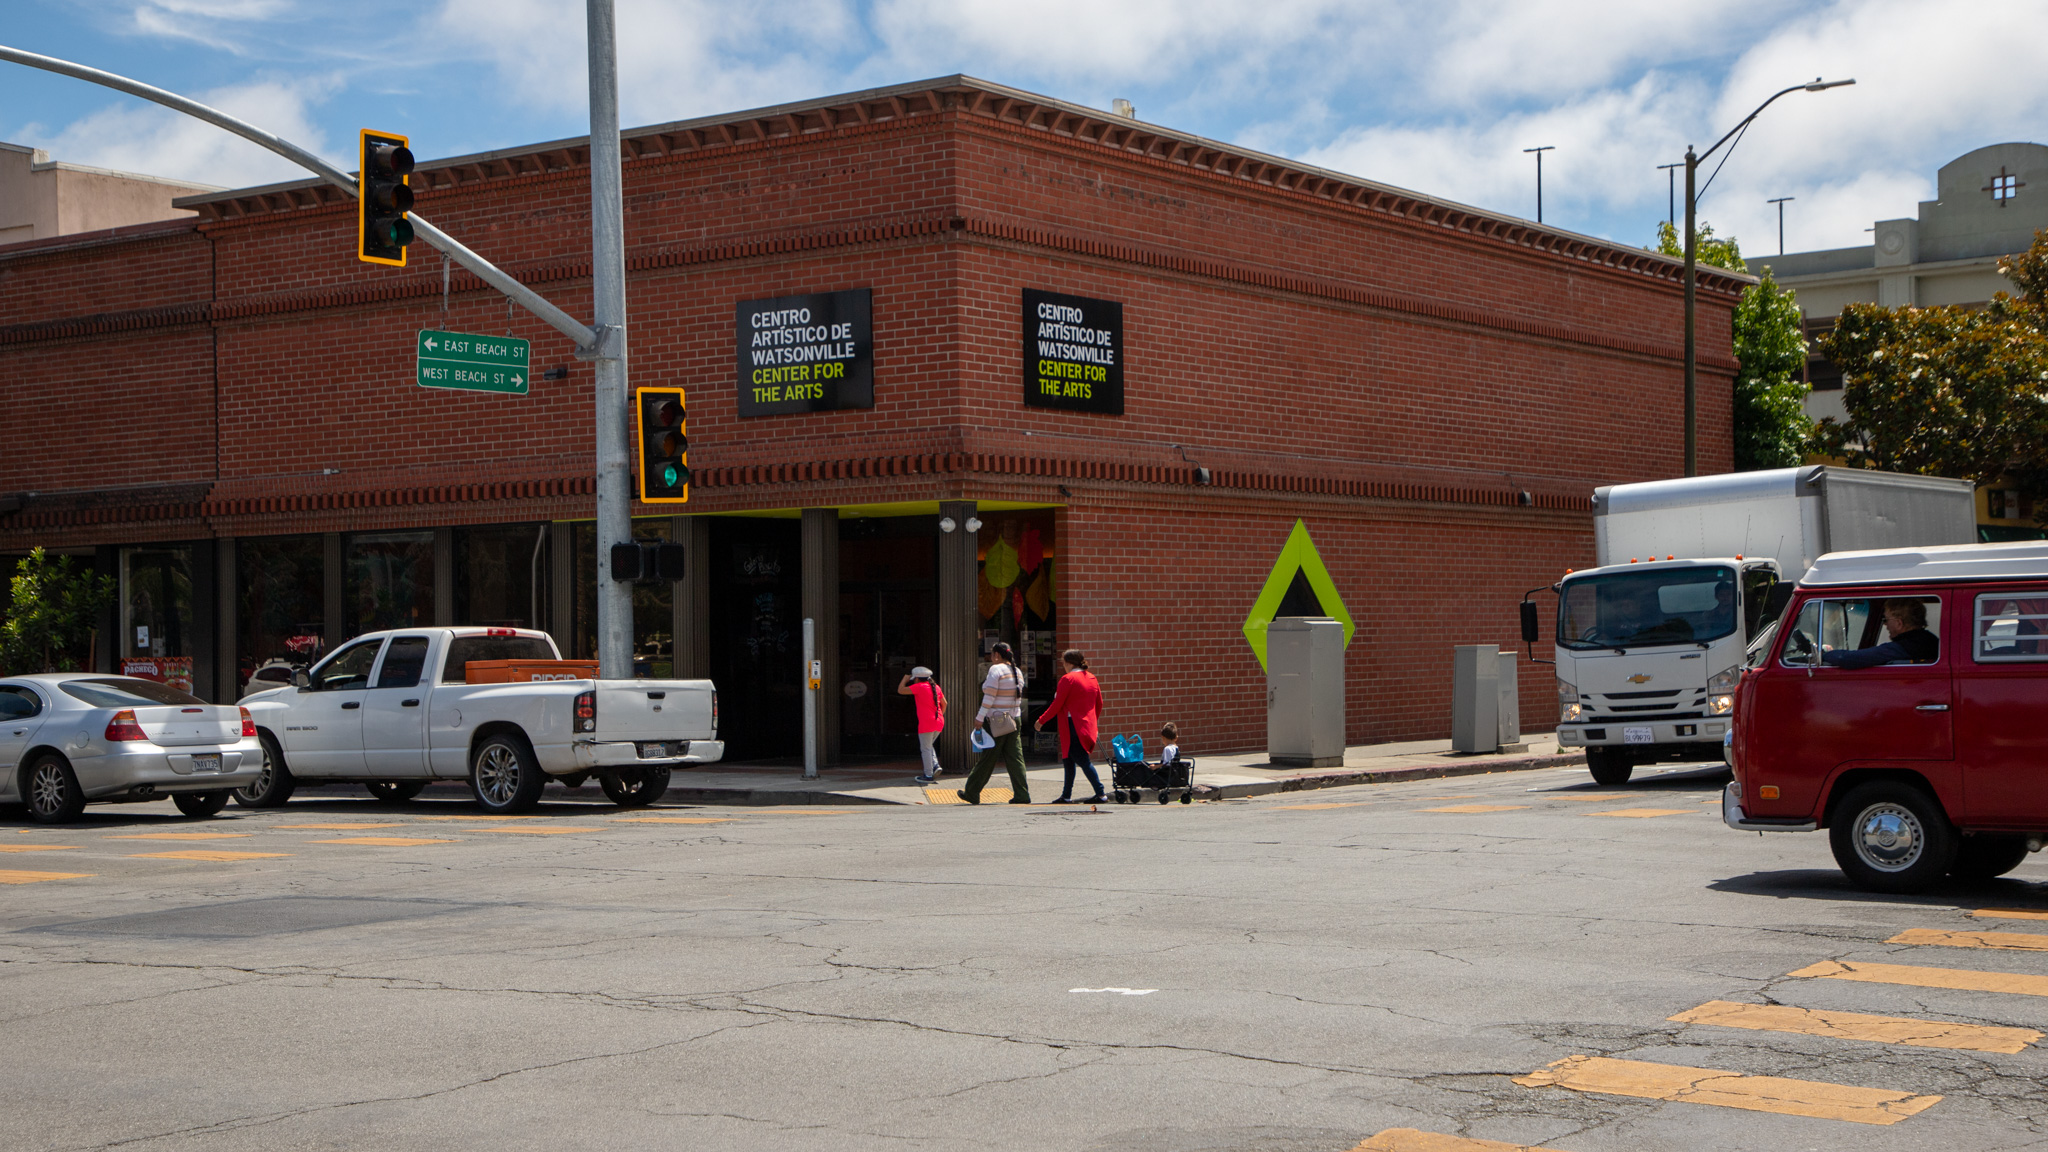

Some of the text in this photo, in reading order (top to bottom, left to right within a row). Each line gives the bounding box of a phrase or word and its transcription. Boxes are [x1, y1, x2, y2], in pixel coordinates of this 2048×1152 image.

[751, 308, 811, 329] CENTRO
[1038, 302, 1083, 324] CENTRO
[751, 322, 852, 348] ARTÍSTICO DE
[1038, 321, 1112, 346] ARTÍSTICO DE
[444, 340, 524, 358] EAST BEACH ST
[751, 342, 856, 366] WATSONVILLE
[1038, 340, 1114, 365] WATSONVILLE
[422, 367, 504, 384] WEST BEACH ST
[752, 362, 844, 384] CENTER FOR
[1038, 360, 1106, 382] CENTER FOR
[752, 383, 824, 403] THE ARTS
[1038, 378, 1092, 399] THE ARTS
[124, 666, 158, 676] PACHECO
